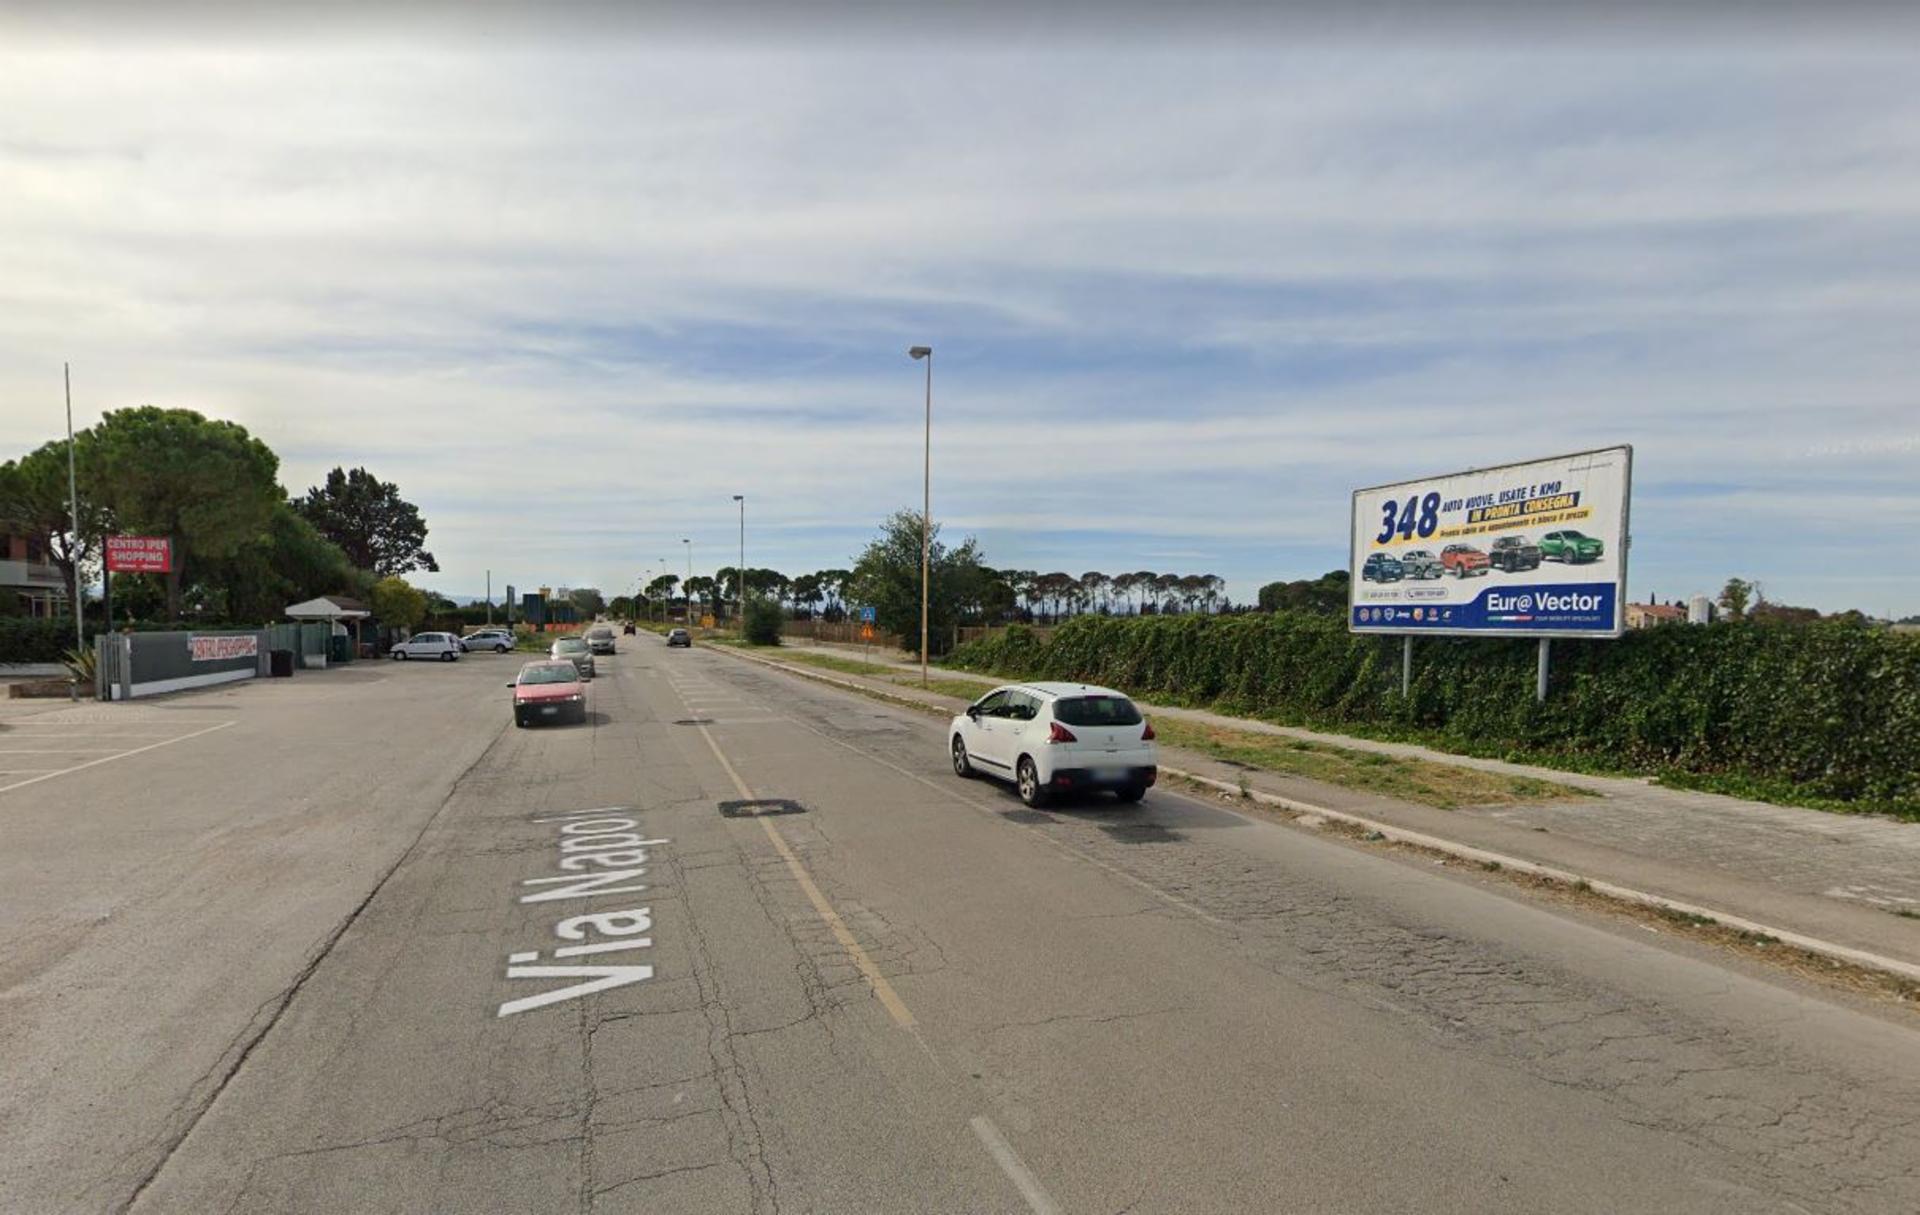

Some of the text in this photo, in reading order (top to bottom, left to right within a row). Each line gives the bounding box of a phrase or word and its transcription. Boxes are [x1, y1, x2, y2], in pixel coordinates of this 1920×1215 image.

[1442, 499, 1463, 513] AUTO
[1499, 487, 1527, 503] USATE
[1529, 485, 1537, 497] E
[1471, 495, 1575, 522] IN PRONTA CONSEGNA
[1376, 492, 1441, 545] 348
[107, 539, 168, 549] CENTRO IPER
[111, 551, 164, 561] SHOPPING
[1487, 591, 1603, 612] Eur@ Vector
